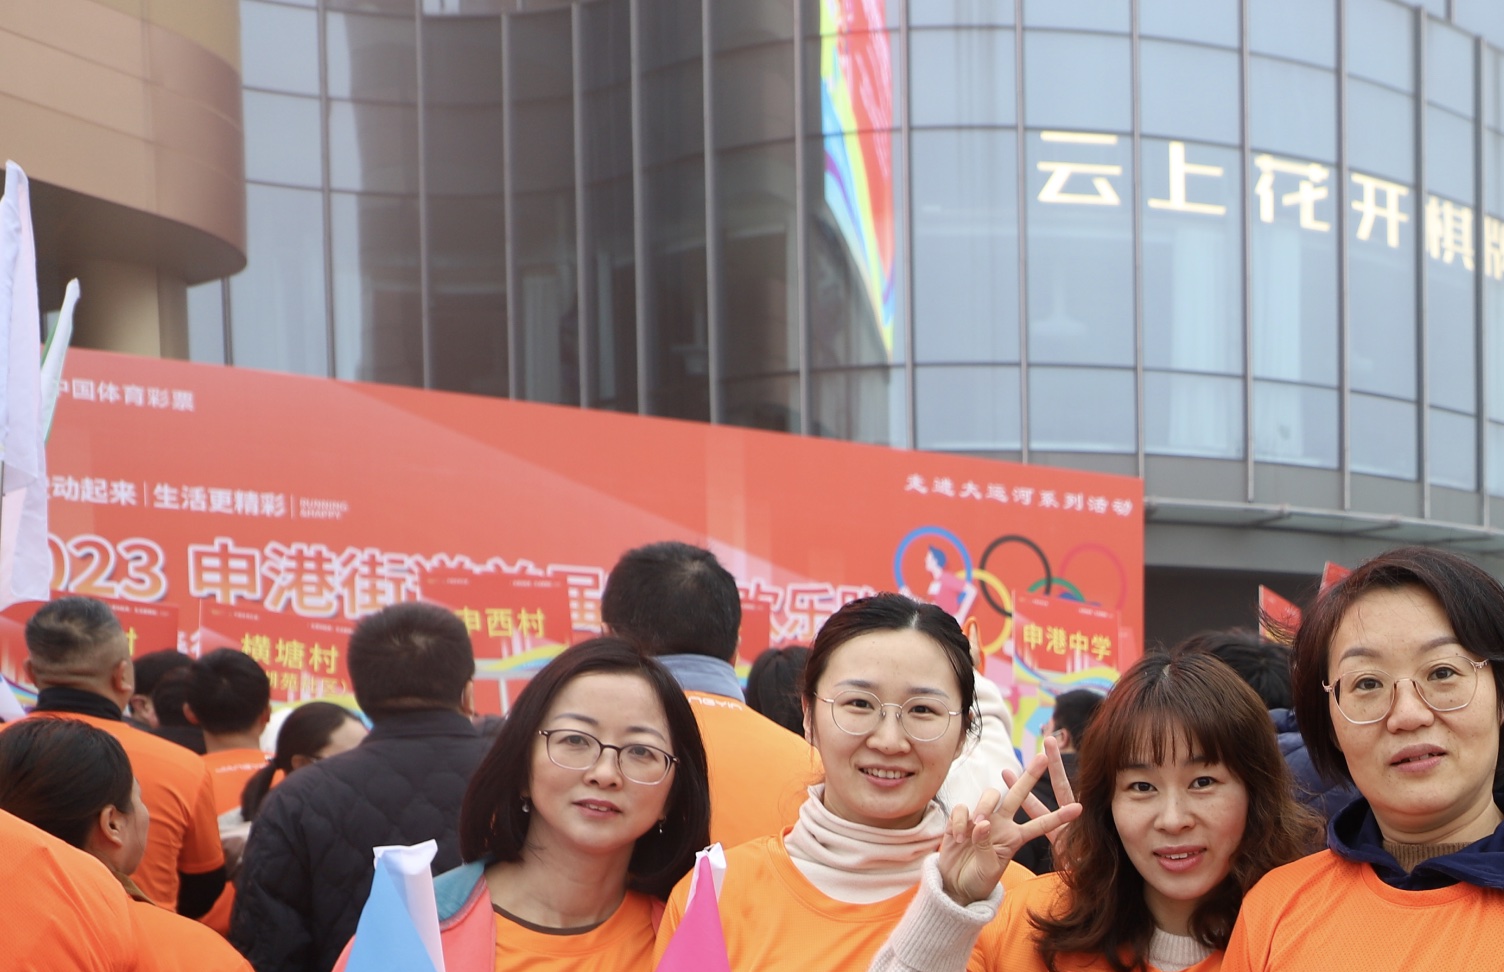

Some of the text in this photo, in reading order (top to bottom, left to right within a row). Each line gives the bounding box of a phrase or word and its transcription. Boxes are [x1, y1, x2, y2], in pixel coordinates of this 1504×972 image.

[46, 475, 286, 517] 动起来 生活更精彩
[904, 473, 1133, 516] 走进大运河系列活动
[241, 631, 339, 674] 横塘村
[1022, 622, 1112, 661] 申港中学
